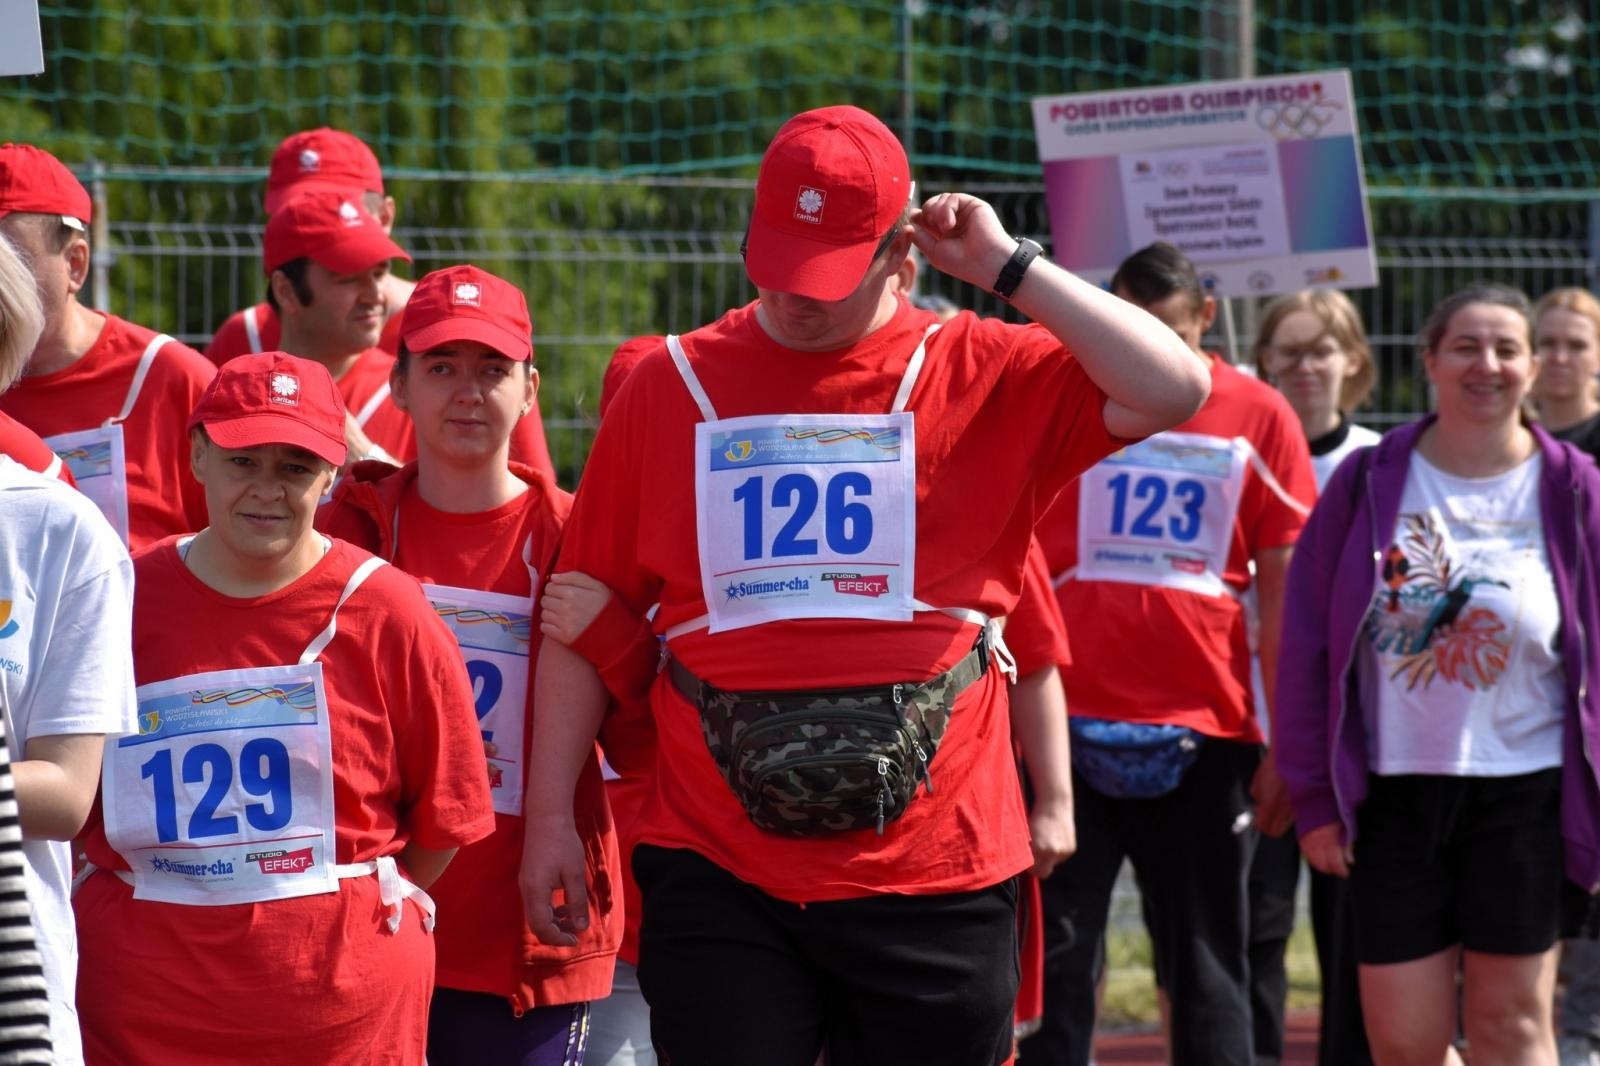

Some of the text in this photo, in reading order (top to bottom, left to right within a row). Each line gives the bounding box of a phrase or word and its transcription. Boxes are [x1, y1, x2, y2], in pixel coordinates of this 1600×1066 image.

[1048, 83, 1311, 122] POWIATOWA OLIMPIADA
[733, 471, 873, 560] 126
[1107, 472, 1206, 543] 123
[739, 576, 809, 597] Summer-cha
[838, 581, 881, 592] EFEKT
[141, 737, 293, 844] 129
[165, 856, 306, 876] Summer-cha EFEKT
[249, 851, 283, 860] STUDIO
